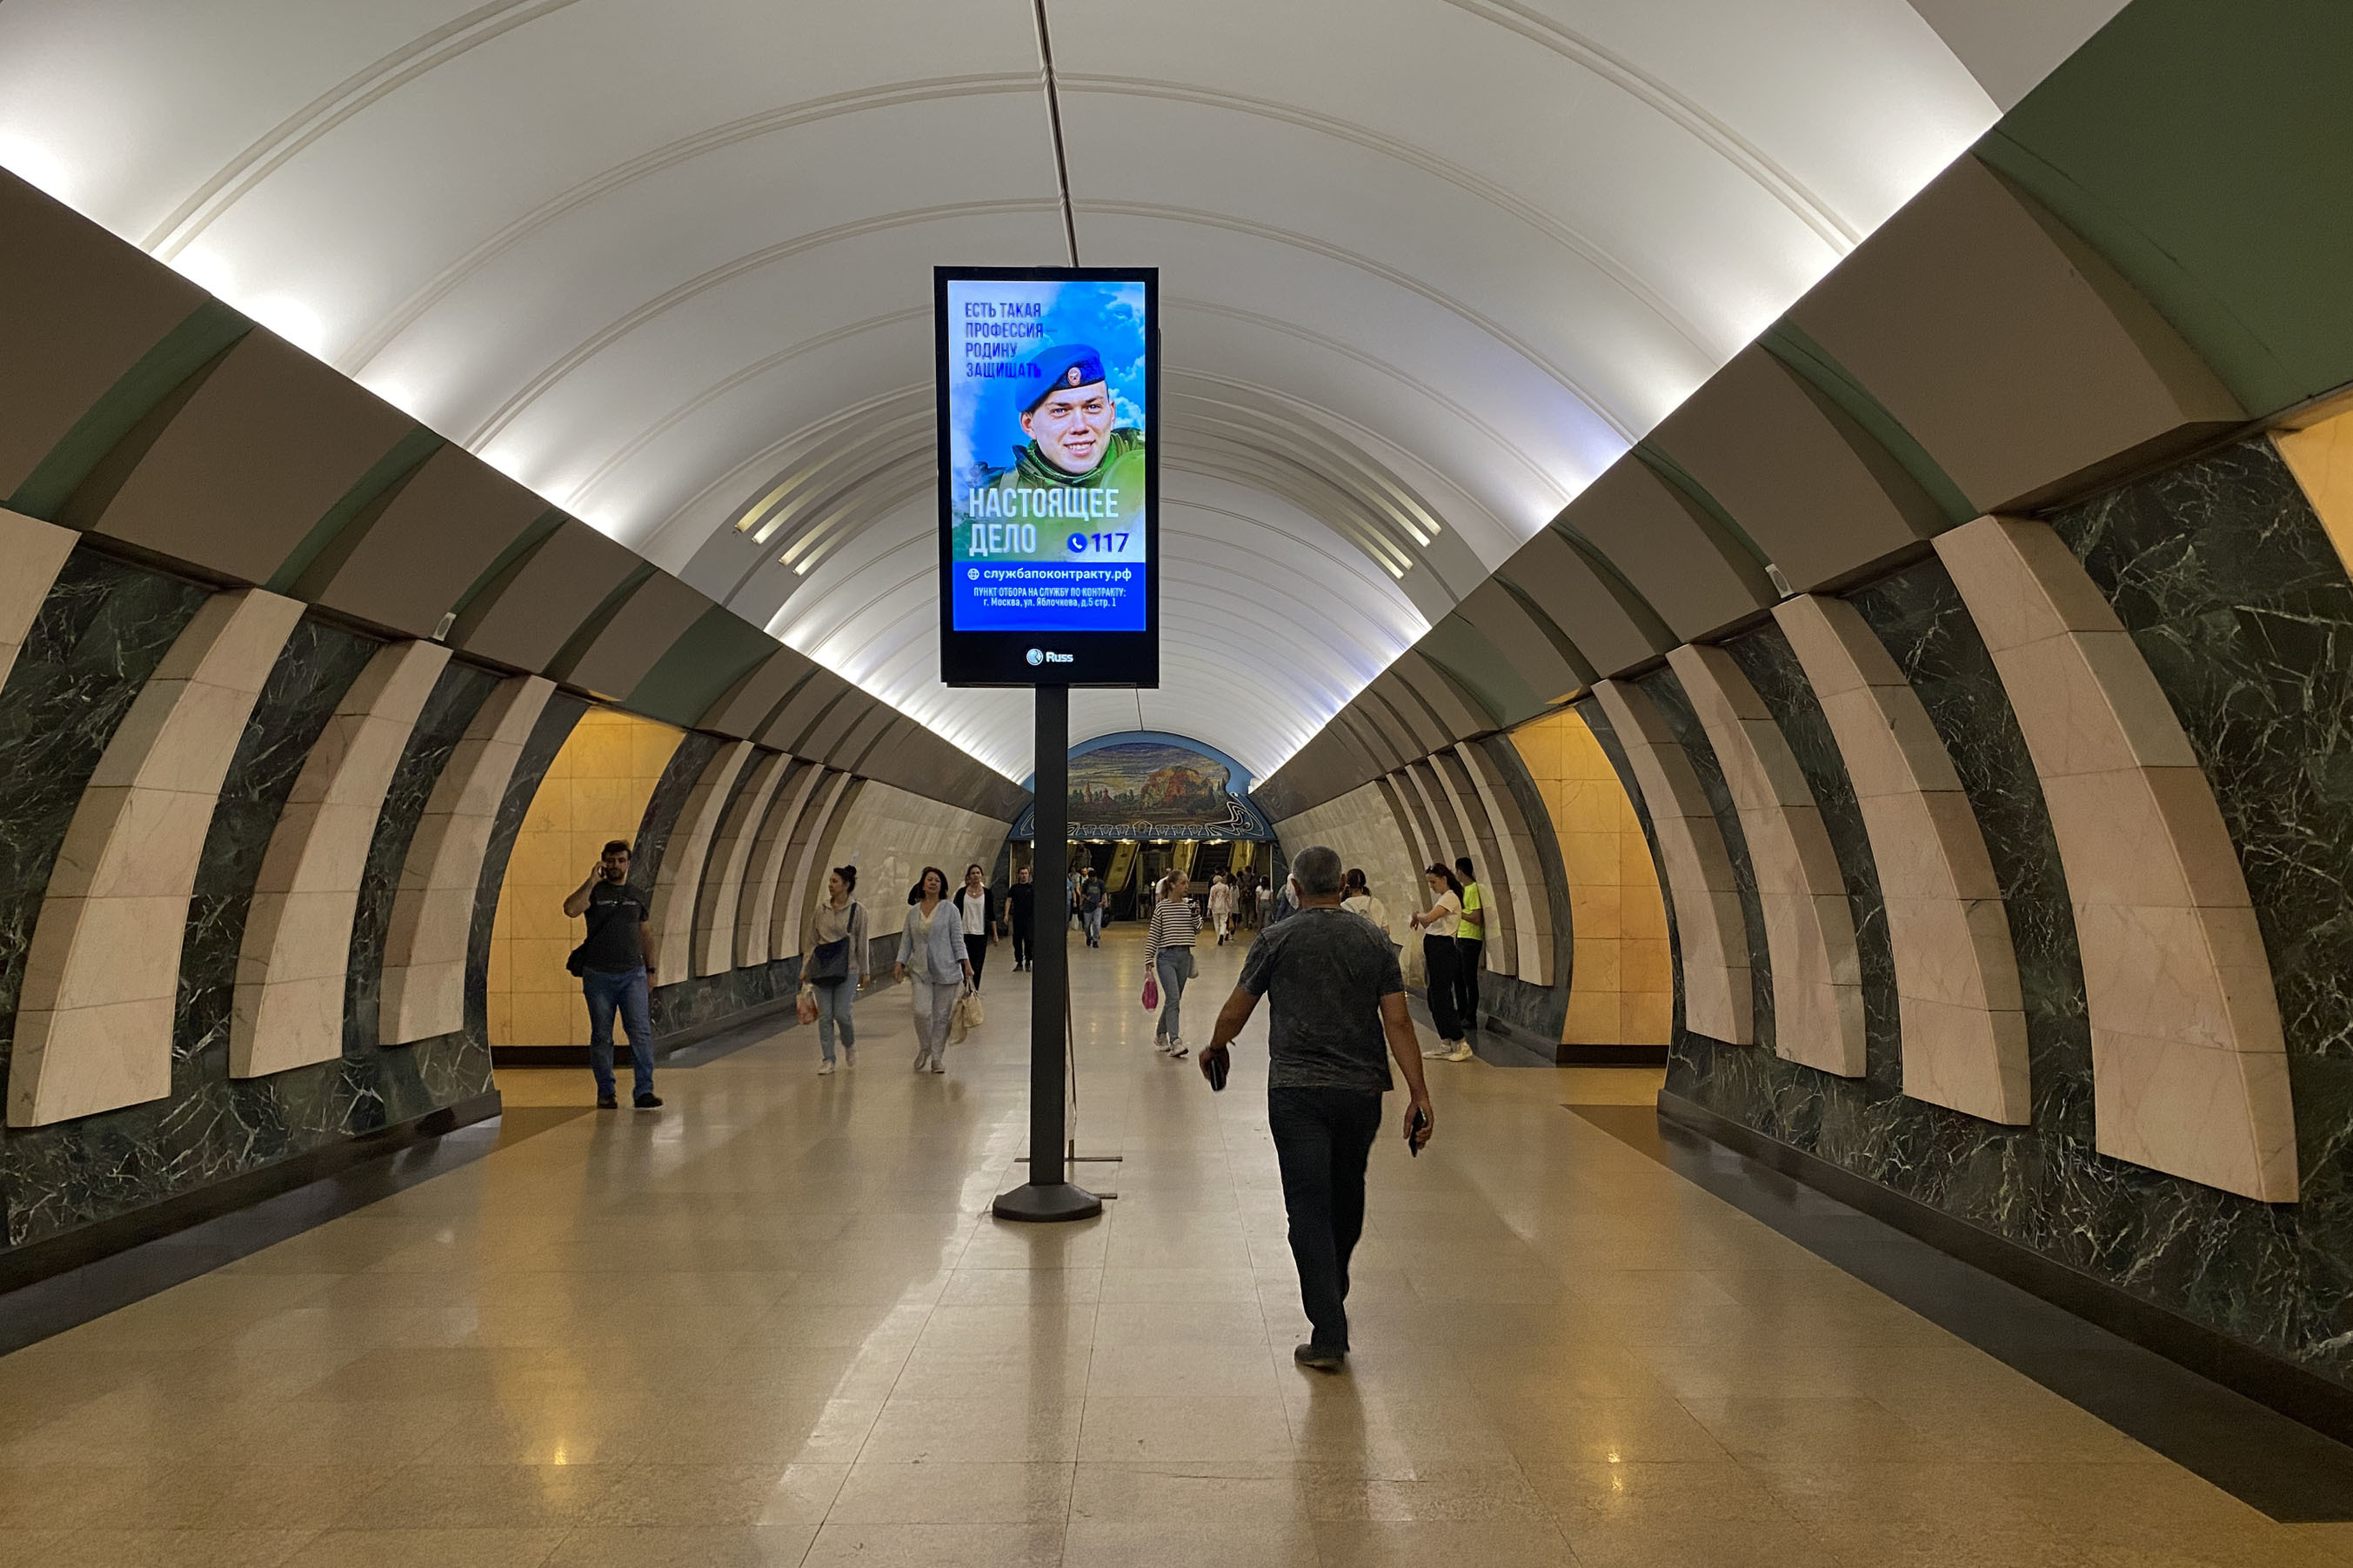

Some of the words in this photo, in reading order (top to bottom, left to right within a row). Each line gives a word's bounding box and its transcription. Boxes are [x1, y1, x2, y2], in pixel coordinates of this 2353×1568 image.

[965, 302, 997, 318] ЕСТЬ
[999, 302, 1041, 318] ТАКАЯ
[966, 322, 1044, 339] ПРОФЕССИЯ
[966, 342, 1018, 360] РОДИНУ
[966, 362, 1042, 380] ЗАЩИЩАТЬ
[969, 487, 1119, 522] НАСТОЯЩЕЕ
[969, 523, 1038, 557] ДЕЛО
[1091, 532, 1130, 553] 117
[983, 567, 1133, 582] службапоконтракту.рф
[973, 587, 997, 597] ПУНКТ
[999, 587, 1026, 597] ОТБОРА
[1028, 587, 1039, 597] НА
[1039, 587, 1069, 597] СЛУЖБУ
[1070, 587, 1081, 597] ПО
[1082, 587, 1127, 597] КОНТРАКТУ:
[991, 597, 1023, 607] Москва,
[1023, 598, 1035, 608] ул.
[1036, 597, 1080, 608] Яблочкова,
[1094, 598, 1111, 608] стр.
[1112, 597, 1117, 607] 1
[1046, 651, 1074, 663] Russ
